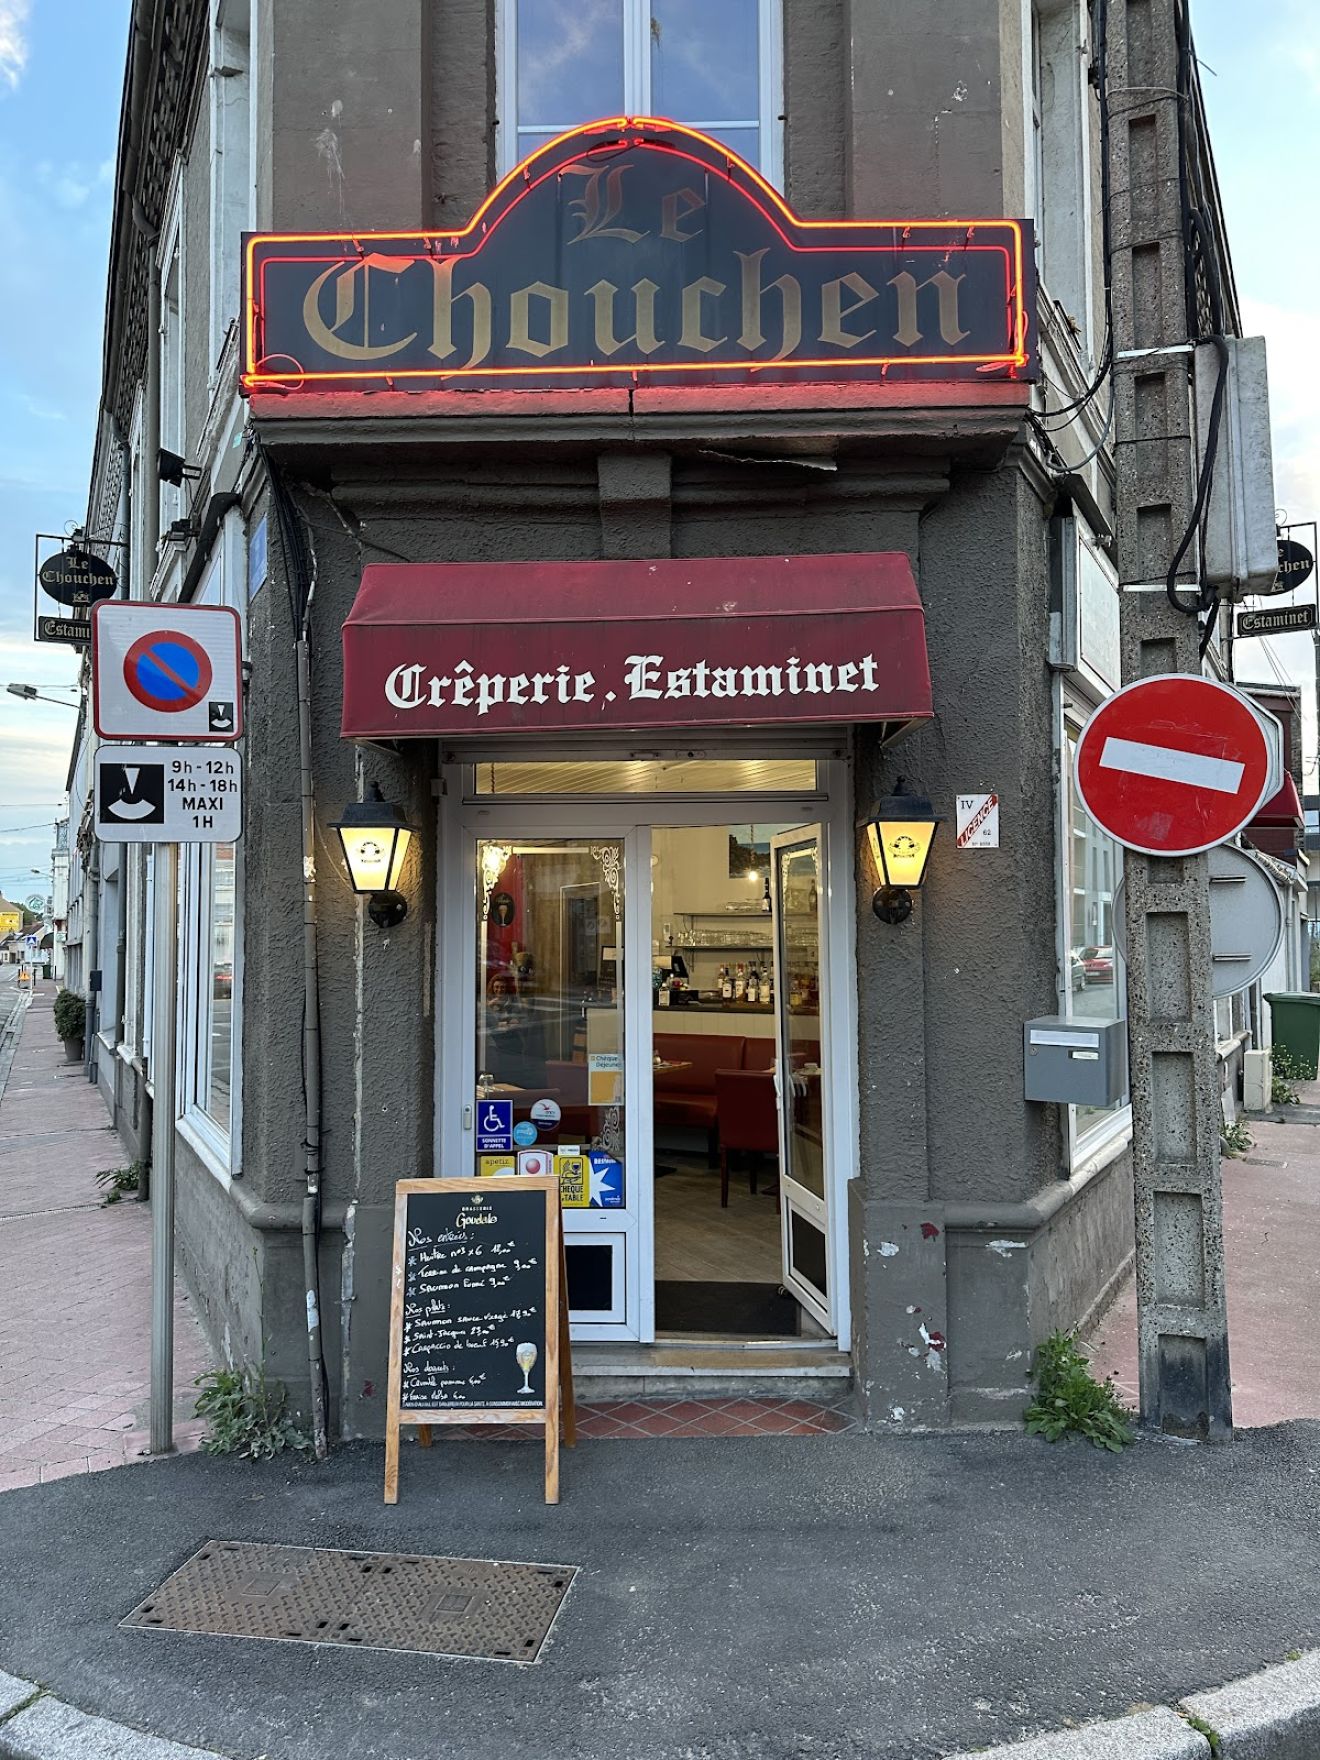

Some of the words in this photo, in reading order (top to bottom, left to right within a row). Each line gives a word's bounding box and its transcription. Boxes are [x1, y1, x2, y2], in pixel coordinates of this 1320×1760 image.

[558, 164, 710, 245] Le
[302, 248, 972, 377] Chouchen
[66, 556, 88, 569] Le
[42, 570, 114, 586] Chouchen
[1242, 610, 1308, 629] Estaminet
[44, 620, 90, 638] Estami
[384, 659, 595, 715] Crêperie
[624, 653, 880, 700] Estaminet
[182, 797, 224, 810] MAXI
[960, 800, 974, 809] IV
[193, 816, 213, 828] 1H
[960, 796, 993, 846] LICENCE
[456, 1212, 498, 1229] Goudale
[408, 1227, 433, 1247] Nos
[451, 1264, 462, 1274] de
[465, 1264, 507, 1274] campagne
[405, 1302, 423, 1316] Nos
[454, 1339, 464, 1350] de
[404, 1362, 420, 1374] Nos
